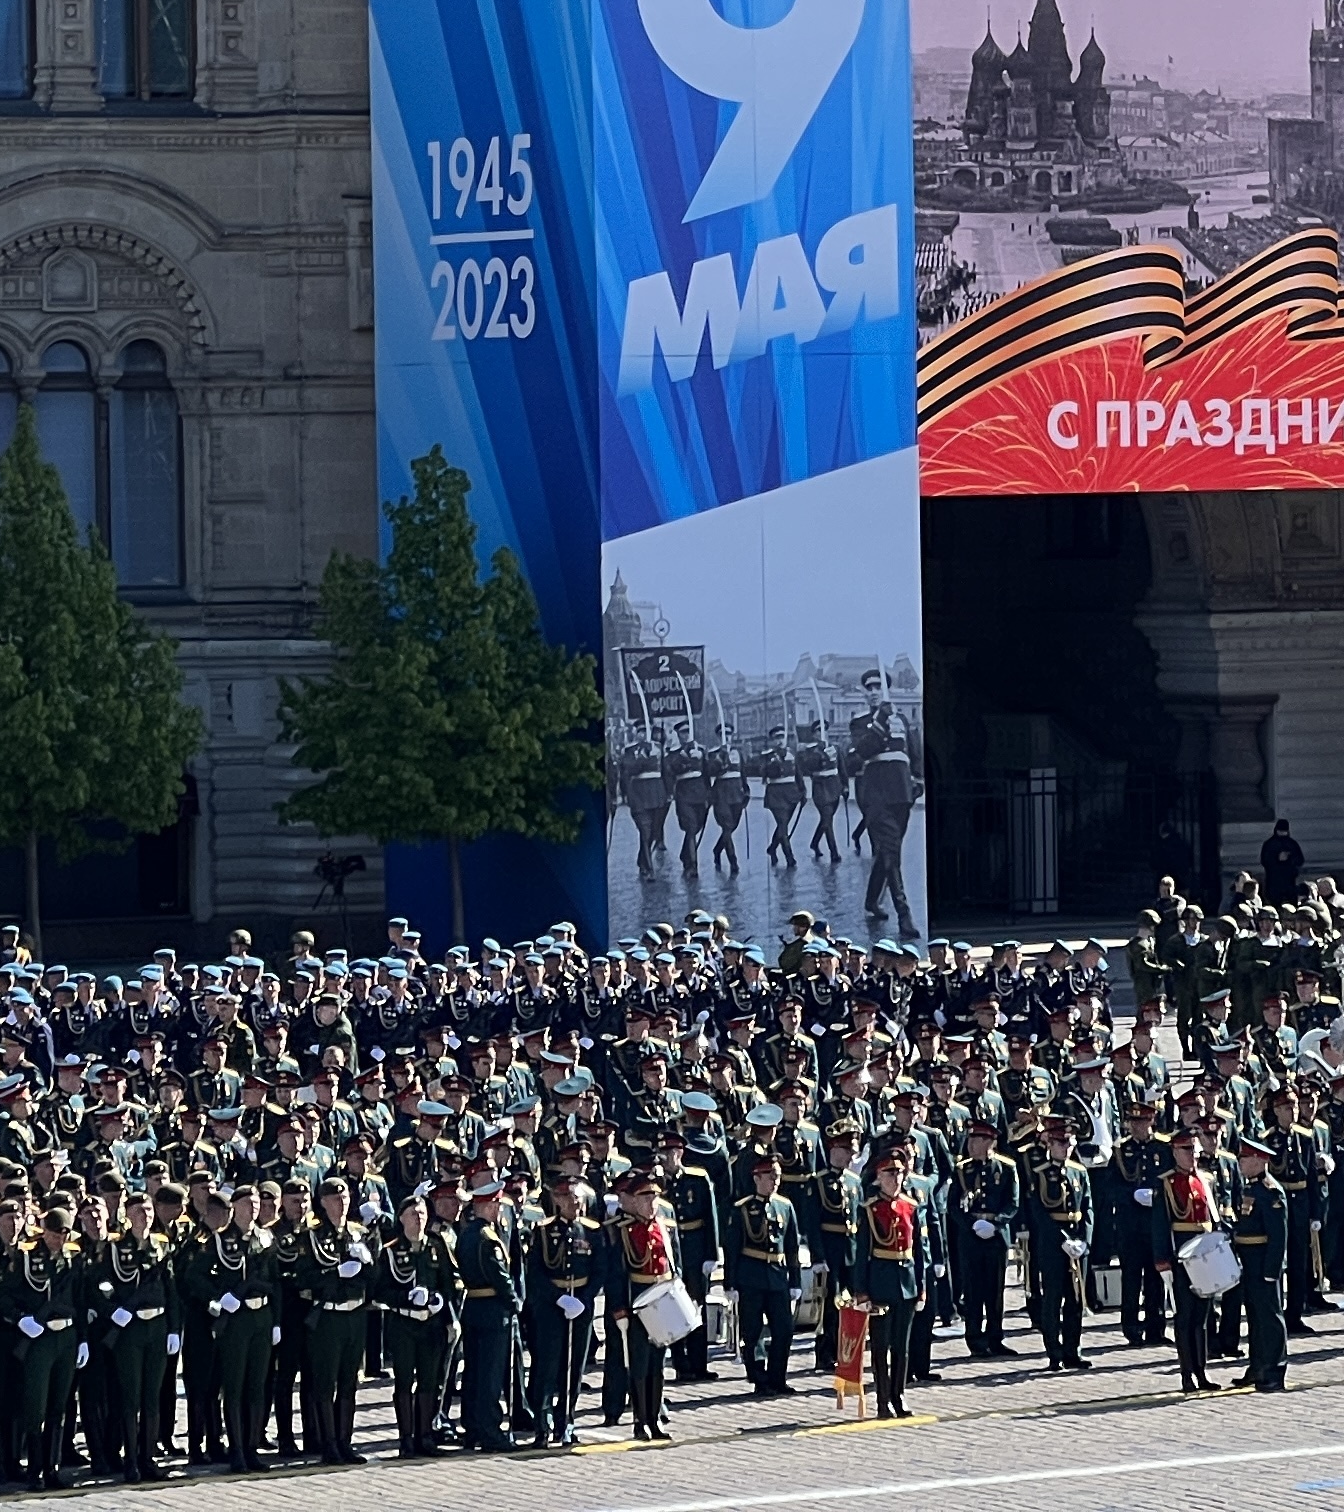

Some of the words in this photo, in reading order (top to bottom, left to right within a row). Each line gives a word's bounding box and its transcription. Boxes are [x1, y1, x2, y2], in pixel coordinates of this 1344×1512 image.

[427, 133, 533, 220] 1945
[430, 255, 536, 340] 2023
[617, 203, 900, 400] МАЯ
[1047, 400, 1080, 450] С
[658, 655, 670, 672] 2
